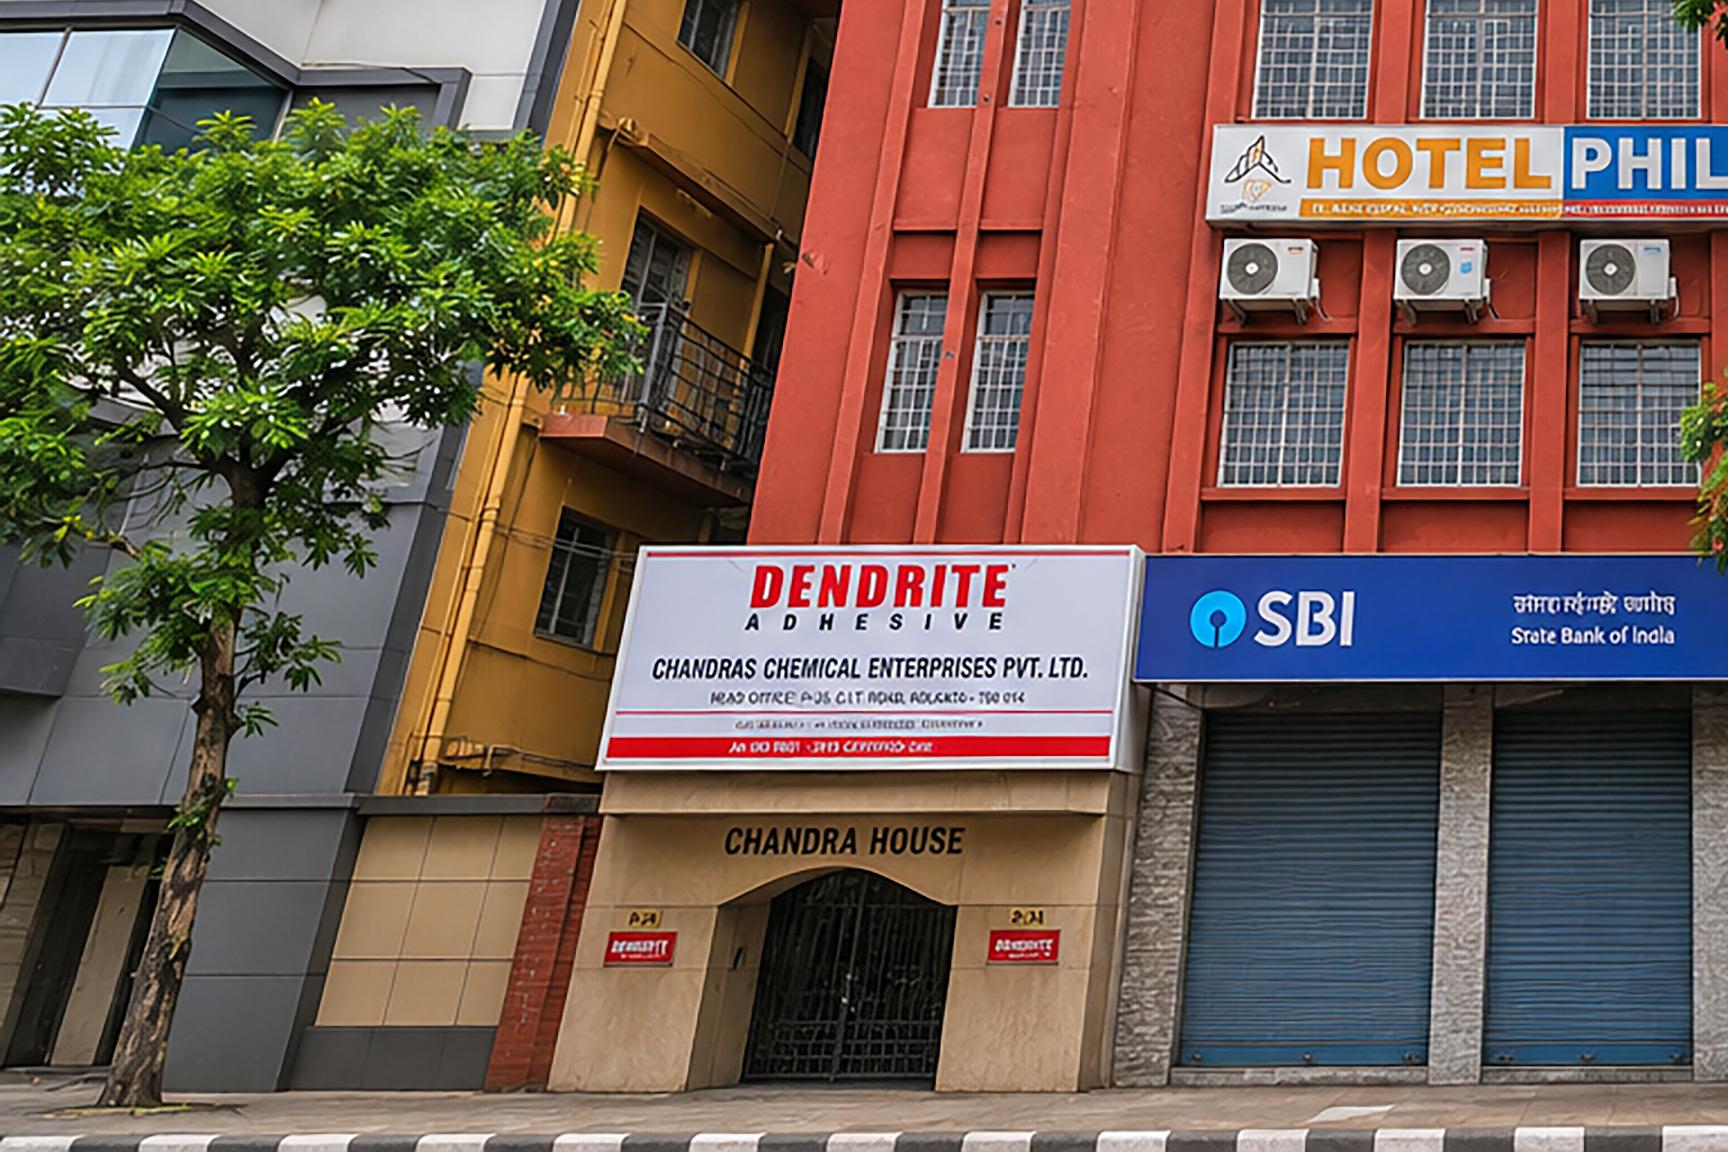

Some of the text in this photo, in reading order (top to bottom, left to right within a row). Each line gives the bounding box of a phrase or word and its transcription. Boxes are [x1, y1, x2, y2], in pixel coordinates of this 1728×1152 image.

[1306, 136, 1552, 190] HOTEL
[749, 564, 1010, 609] DENDRITE
[744, 612, 1003, 631] ADHESIVE
[1254, 590, 1355, 647] SBI
[1561, 626, 1606, 645] Bank
[1609, 626, 1628, 645] of
[652, 657, 1088, 680] CHANDRAS CHEMICAL ENTERPRISES PVT. LTD.
[724, 826, 966, 856] CHANDRA HOUSE
